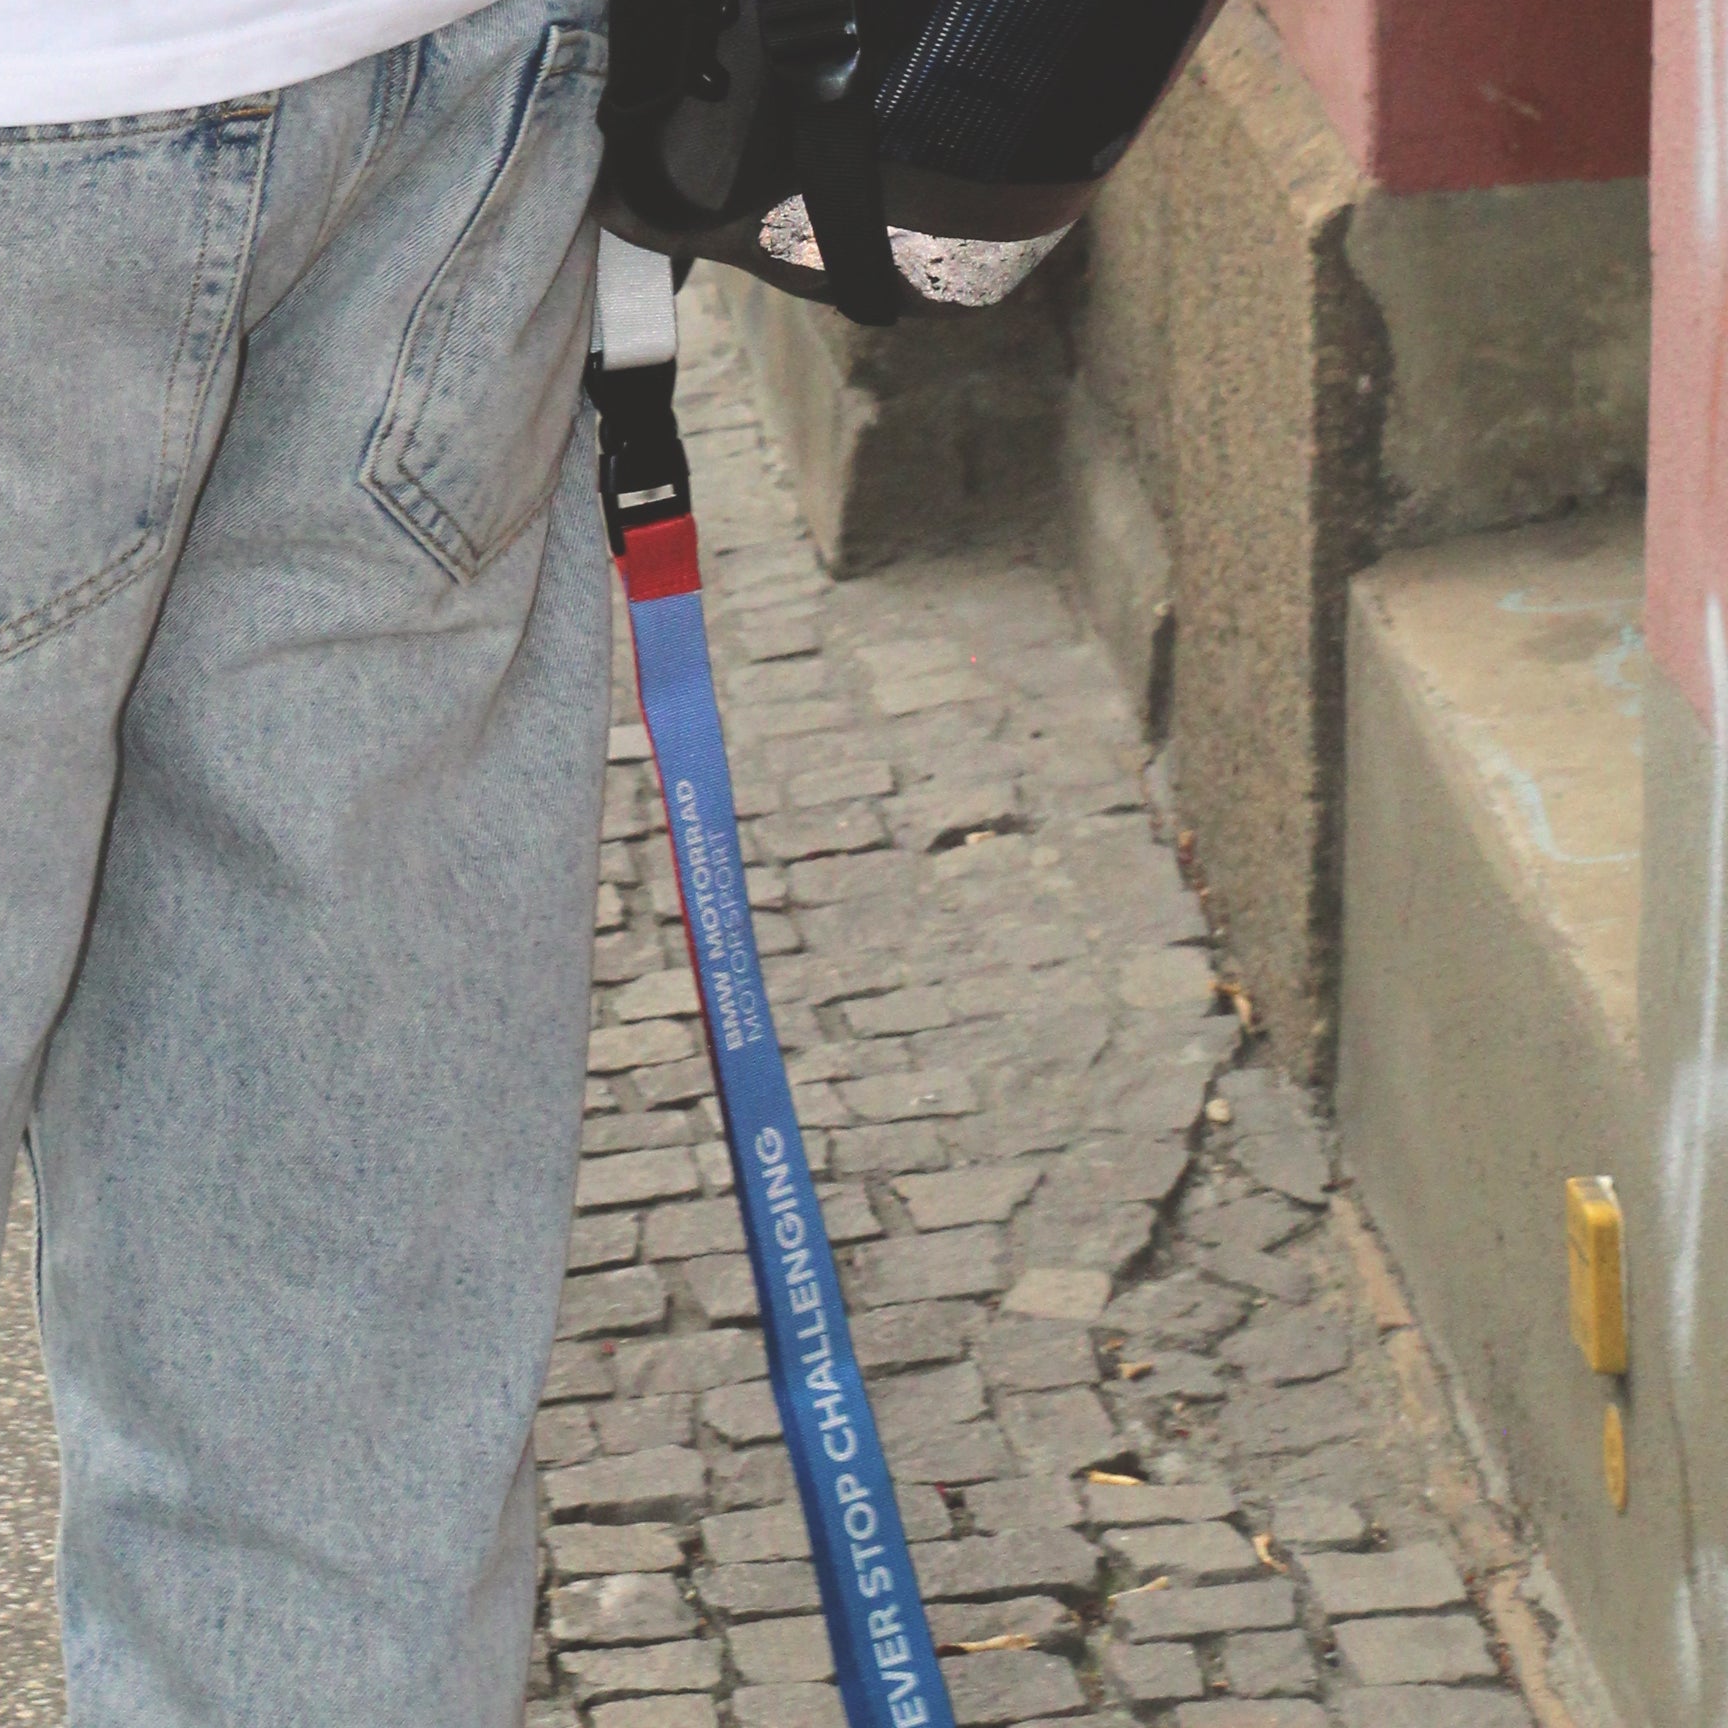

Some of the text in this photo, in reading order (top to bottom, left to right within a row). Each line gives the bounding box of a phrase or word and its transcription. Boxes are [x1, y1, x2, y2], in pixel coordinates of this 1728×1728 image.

[676, 778, 744, 1051] BMW MOTORRAD
[754, 1126, 859, 1463] CHALLENGING
[835, 1472, 894, 1599] STOP
